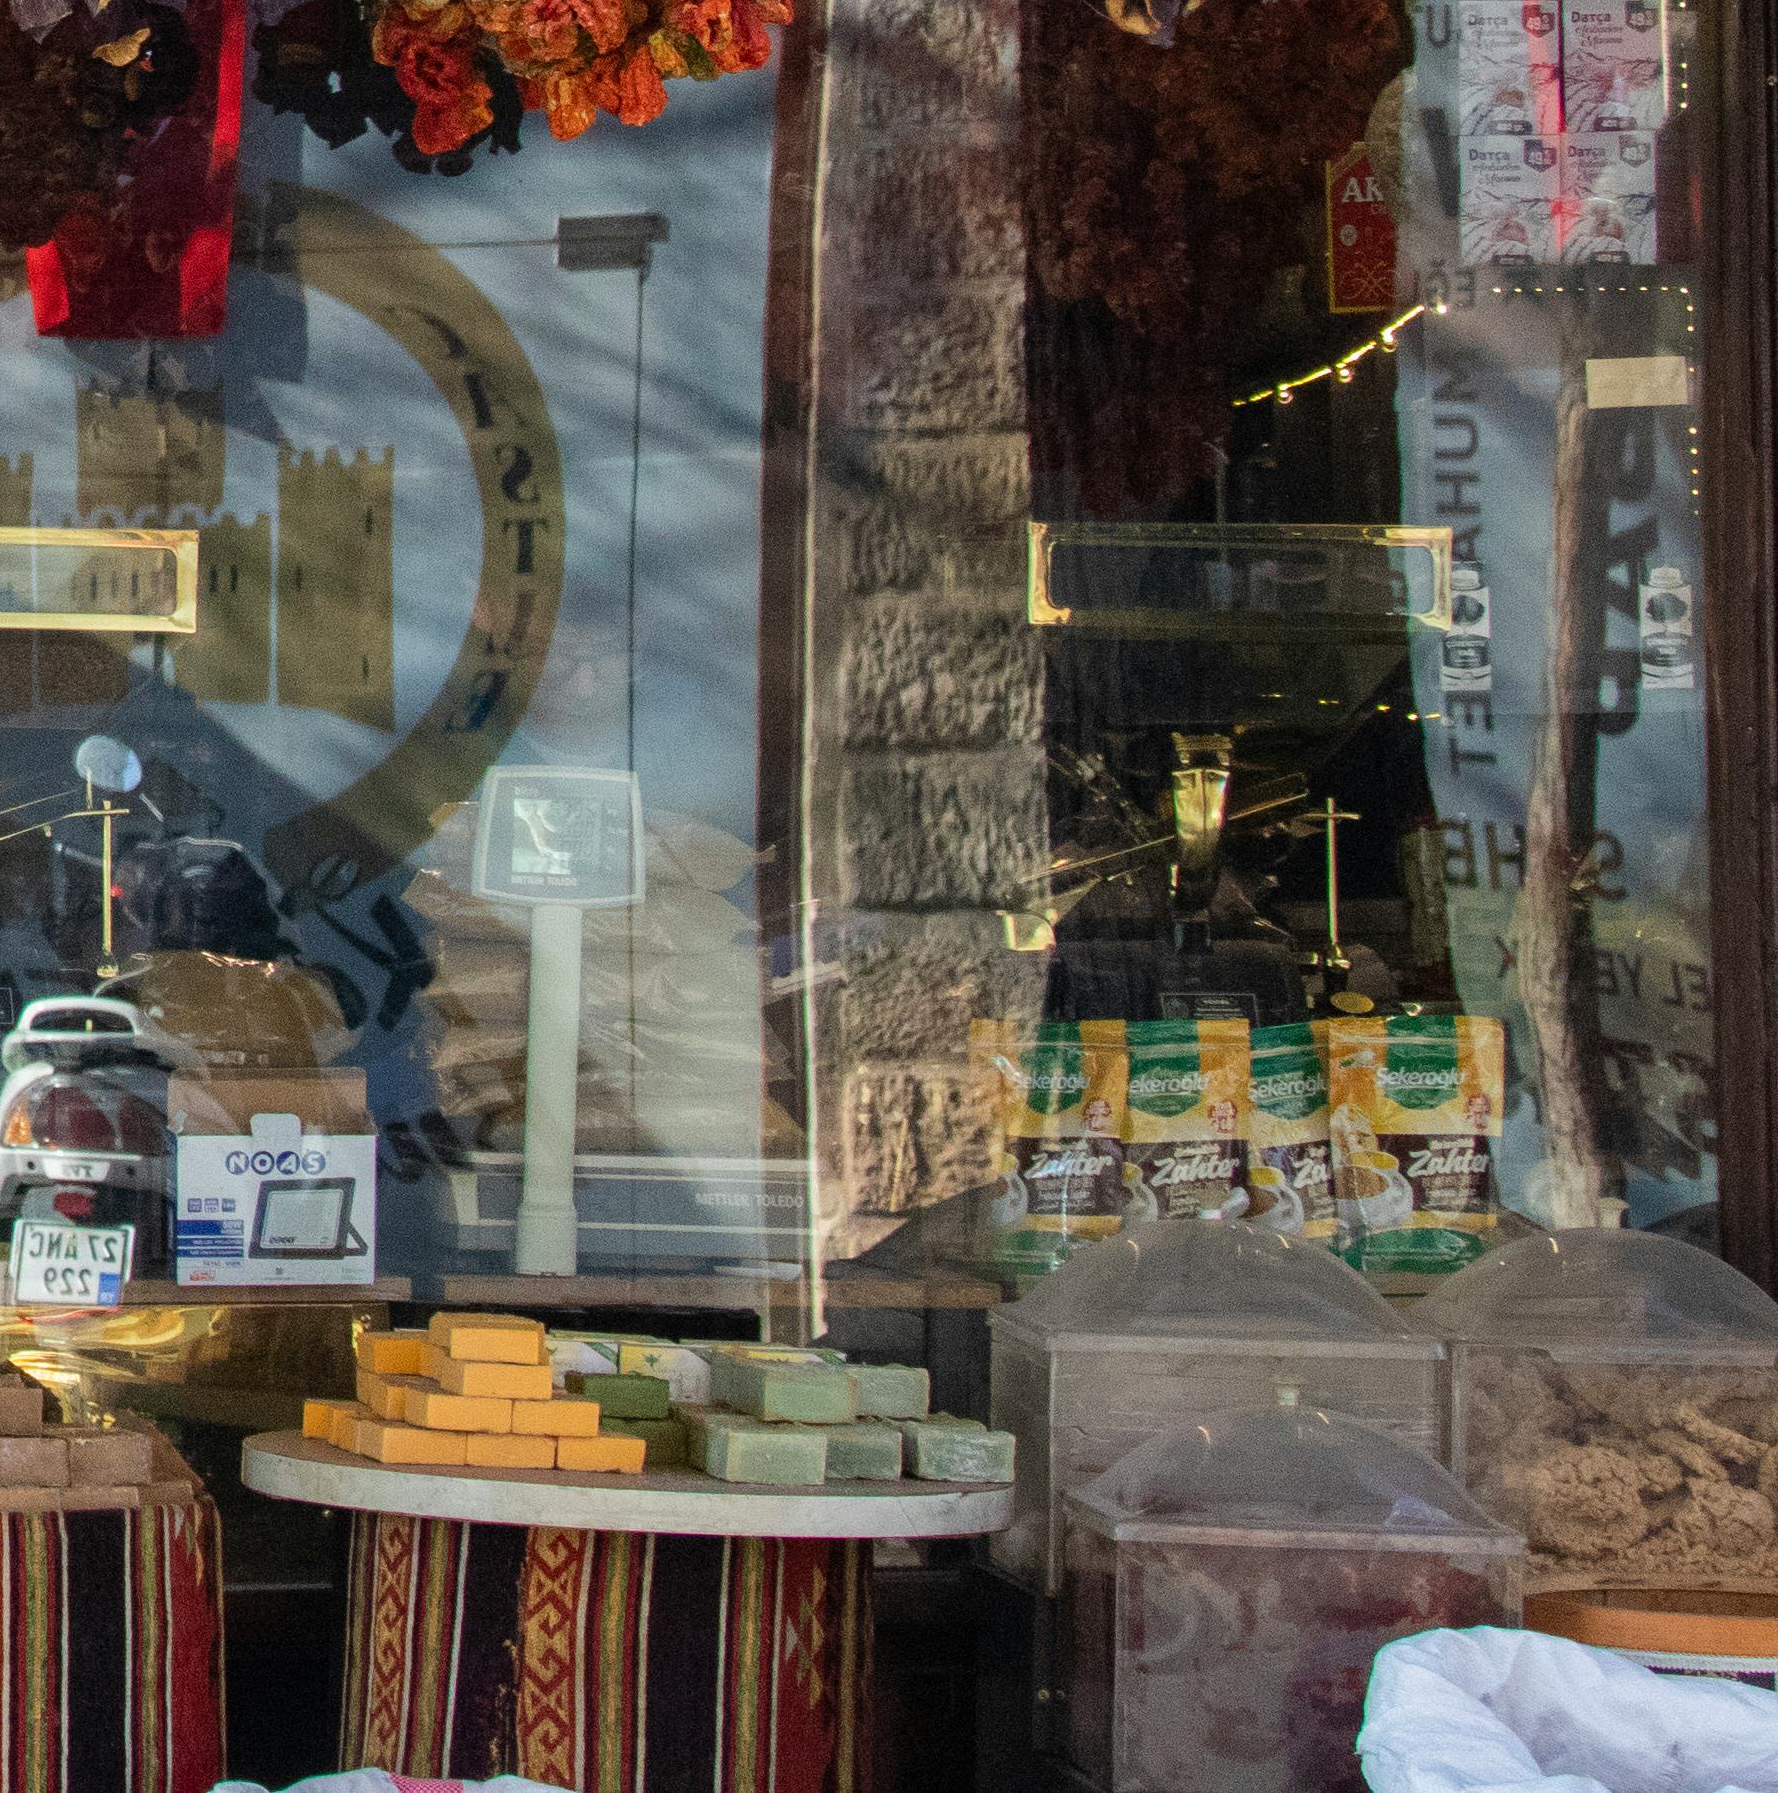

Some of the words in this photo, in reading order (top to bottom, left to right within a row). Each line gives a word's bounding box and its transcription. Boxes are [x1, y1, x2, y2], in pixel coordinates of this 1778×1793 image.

[225, 1150, 326, 1176] NOAS
[1150, 1156, 1241, 1187] Zahter
[1407, 1146, 1491, 1178] Zahter
[754, 1193, 805, 1208] TOLEDO
